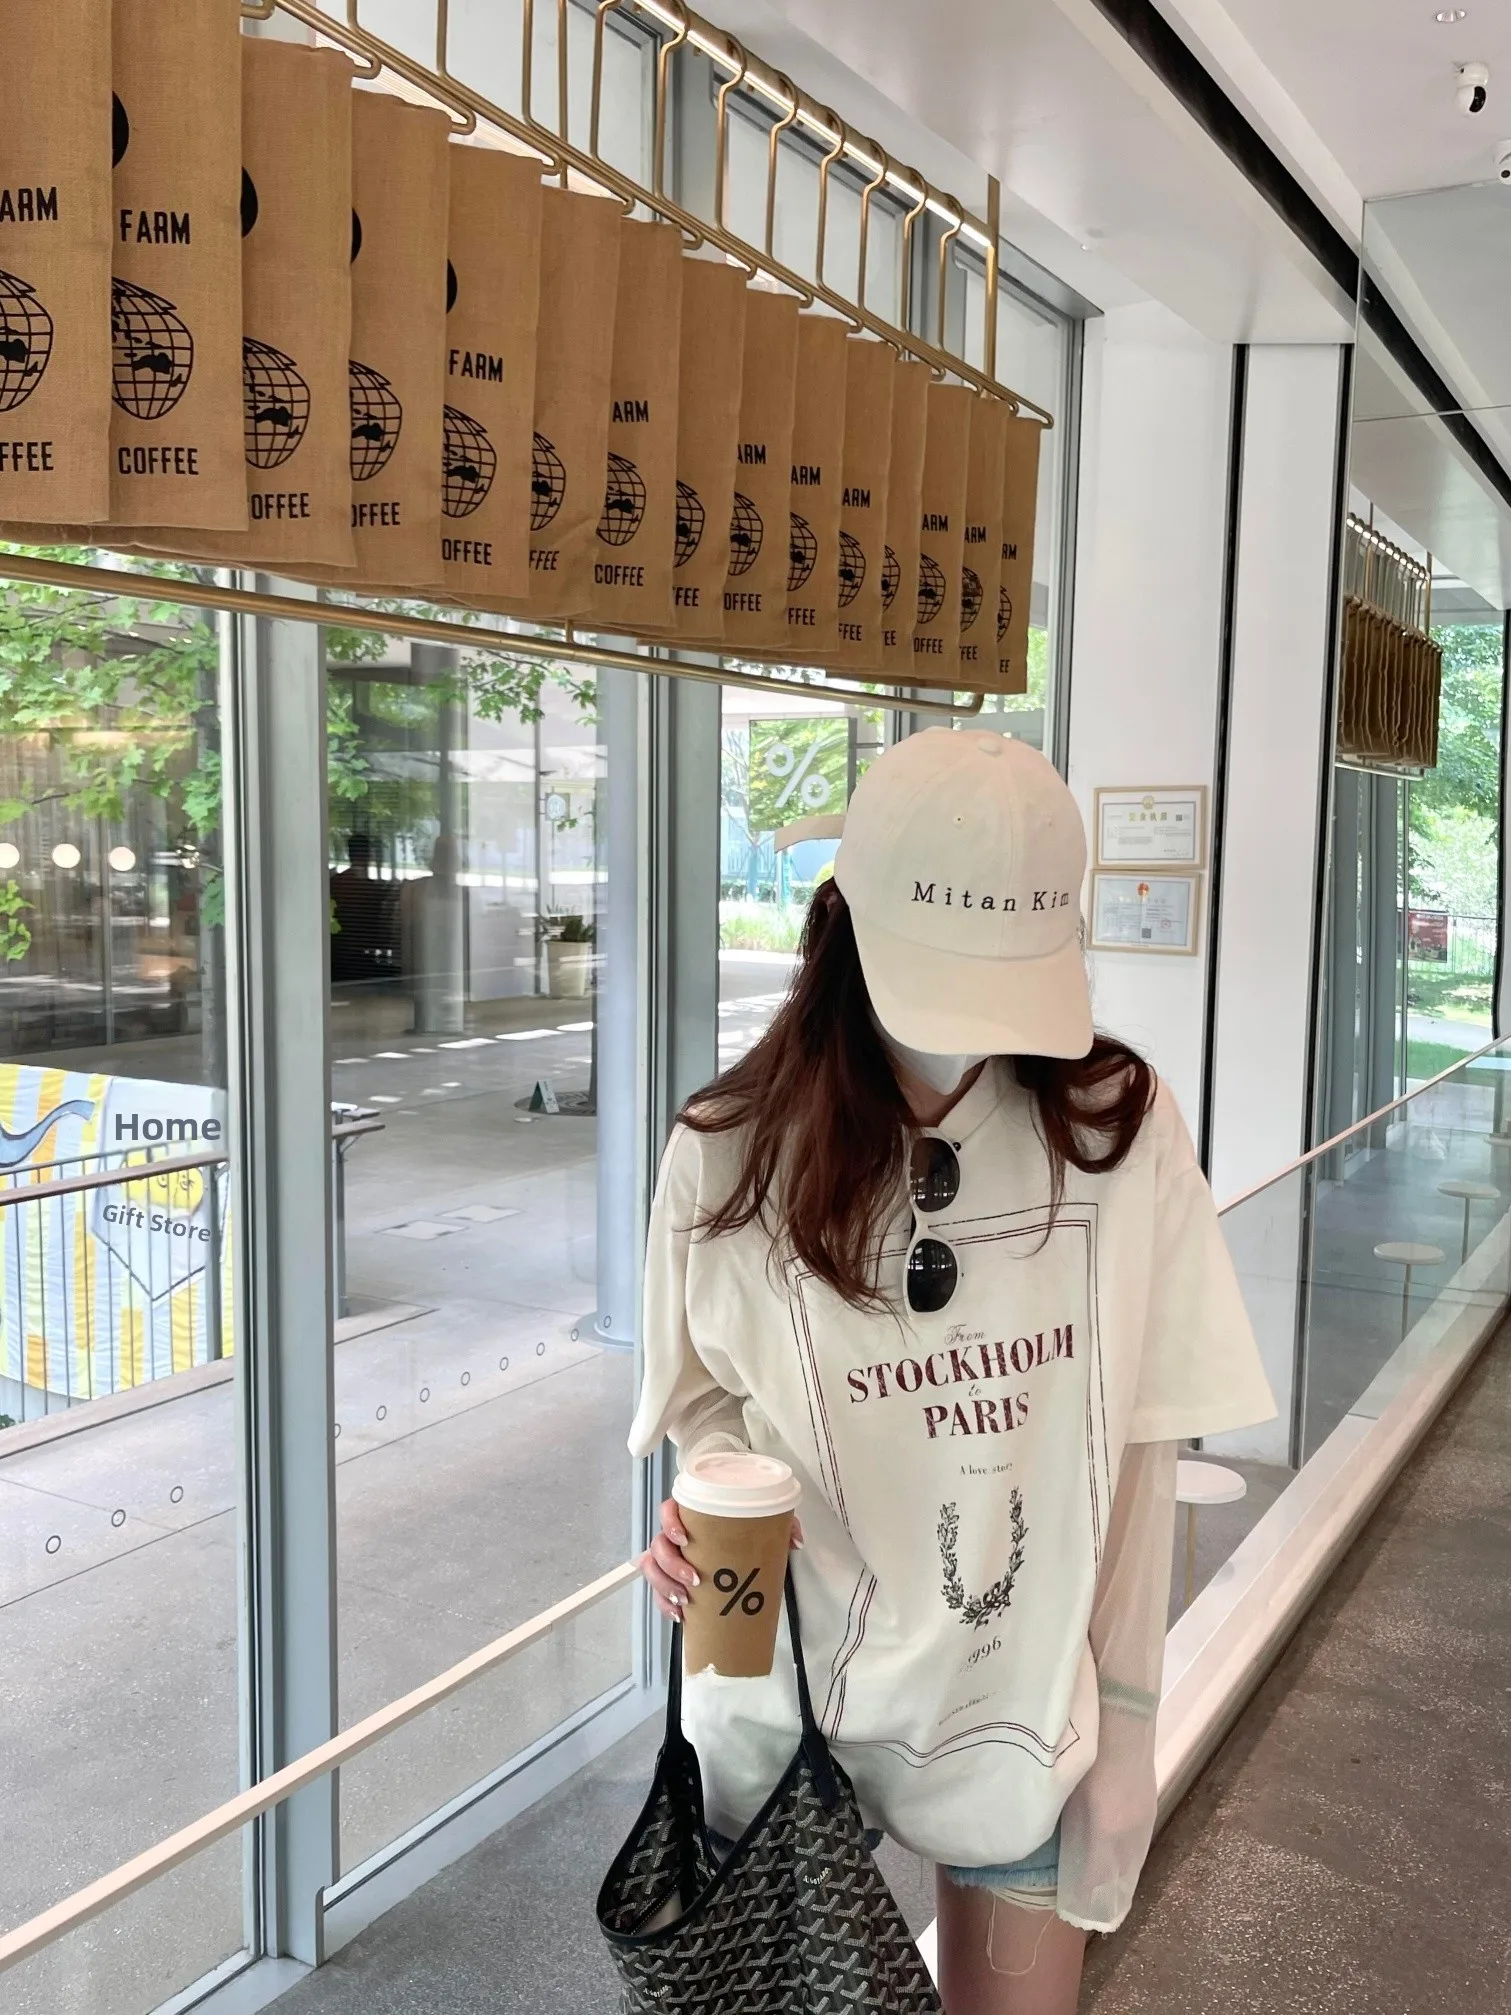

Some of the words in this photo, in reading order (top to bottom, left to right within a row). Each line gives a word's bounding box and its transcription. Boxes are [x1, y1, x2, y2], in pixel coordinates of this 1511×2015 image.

[120, 208, 191, 244] FARM
[448, 349, 503, 382] FARM
[118, 447, 199, 475] COFFEE
[594, 563, 645, 587] COFFEE
[672, 586, 700, 607] FEE
[911, 881, 1016, 911] Mitan
[115, 1113, 222, 1141] Home
[102, 1204, 144, 1228] Gift
[150, 1214, 211, 1242] Store
[945, 1323, 986, 1345] From
[846, 1323, 1075, 1404] STOCKHOLM
[922, 1391, 1031, 1440] PARIS
[969, 1464, 987, 1475] love
